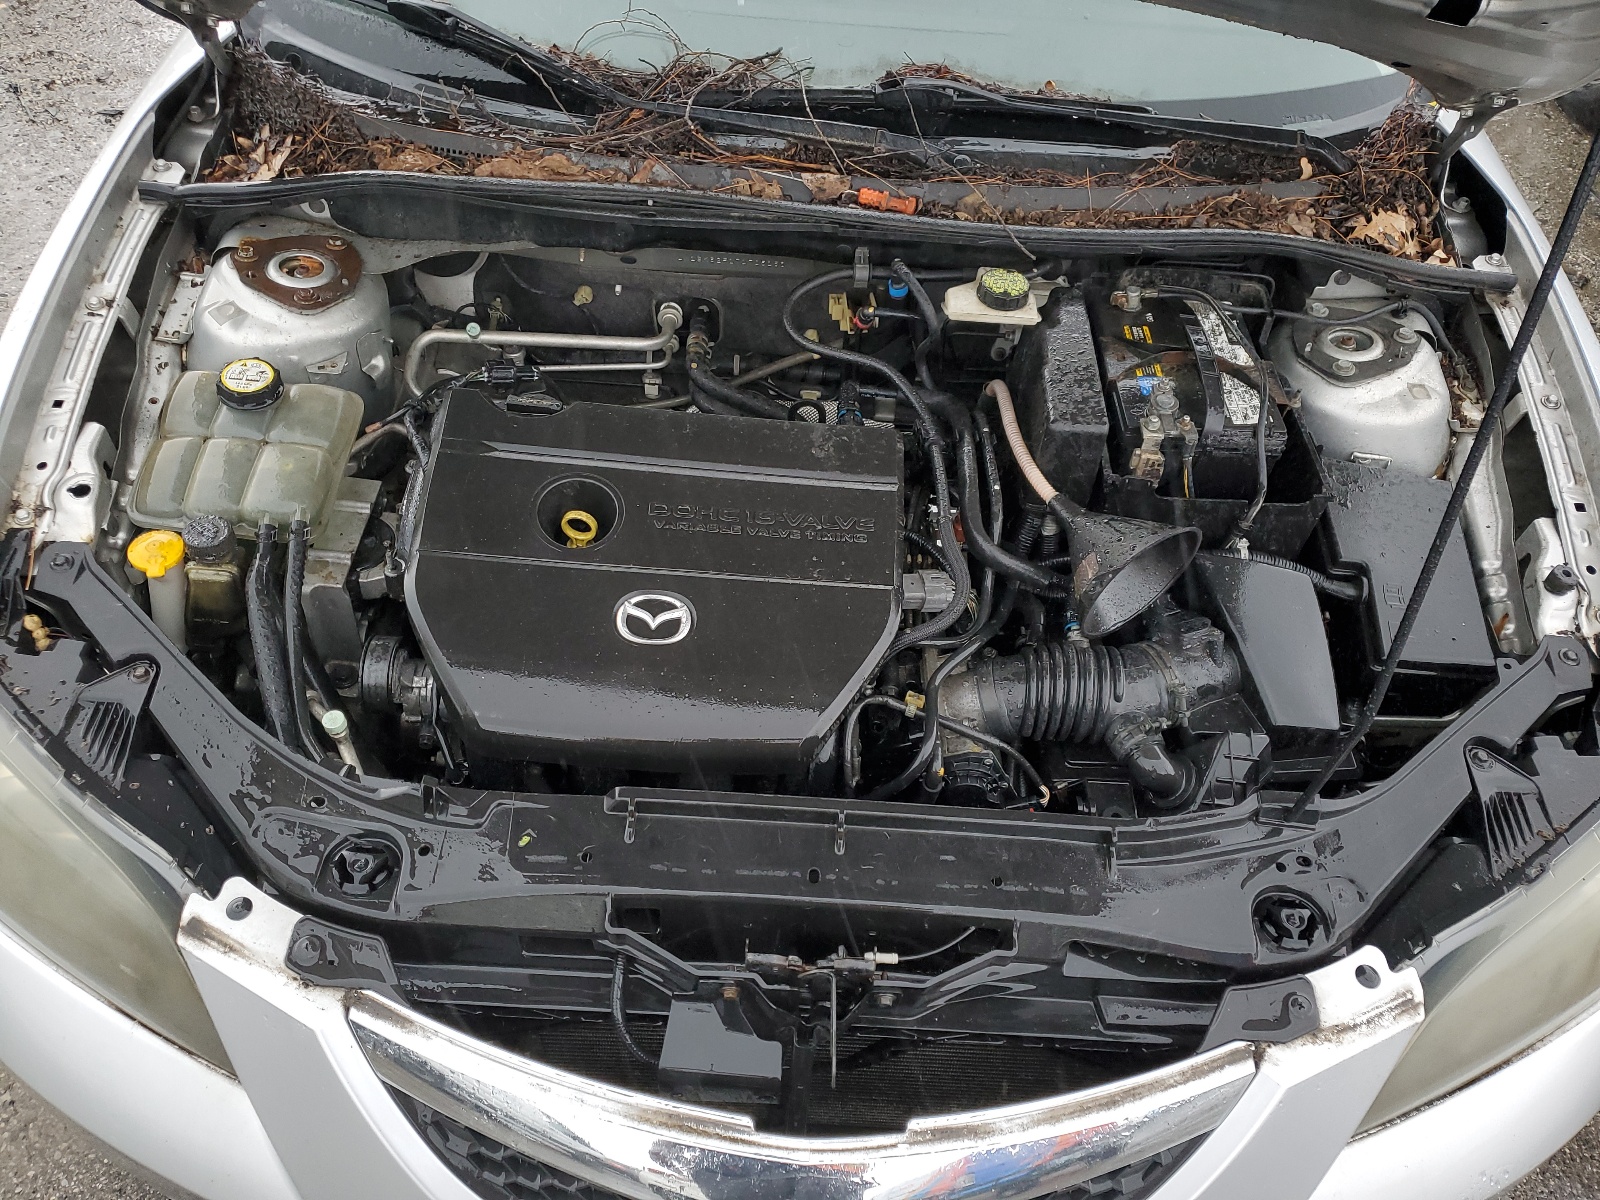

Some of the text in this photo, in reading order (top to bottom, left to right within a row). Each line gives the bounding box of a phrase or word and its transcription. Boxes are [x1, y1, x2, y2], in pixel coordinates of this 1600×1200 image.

[653, 519, 869, 543] VARIABLE VALVE TIMING
